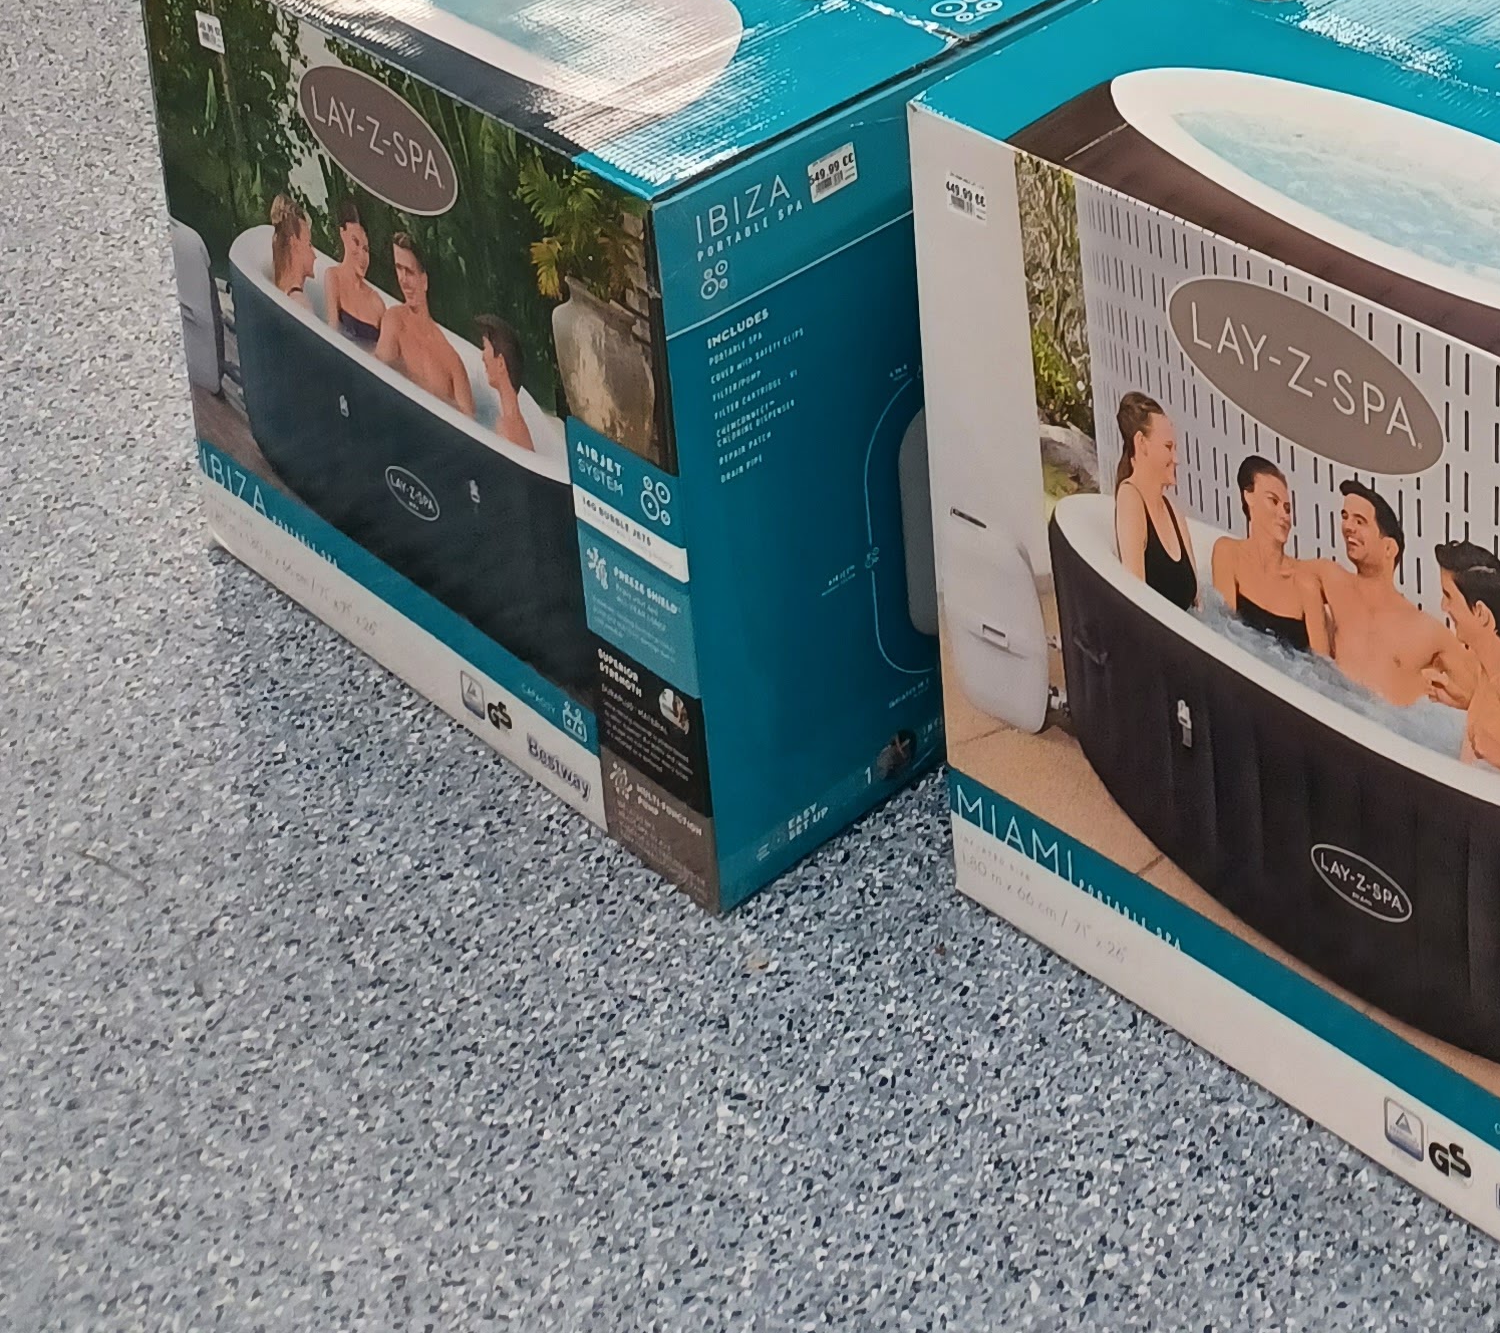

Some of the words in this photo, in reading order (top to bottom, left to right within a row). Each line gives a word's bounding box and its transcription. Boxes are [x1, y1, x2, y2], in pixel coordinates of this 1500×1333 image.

[311, 85, 445, 190] LAY-Z-SPA
[696, 174, 790, 244] IBIZA
[697, 217, 768, 262] PORTABLE
[777, 200, 803, 221] SPA
[706, 308, 769, 349] INCLUDES
[1191, 301, 1423, 449] LAY-Z-SPA
[576, 441, 622, 477] AIRJET
[578, 458, 624, 497] SYSTEM
[202, 448, 267, 518] IBIZA
[598, 507, 630, 533] BUBBLE
[632, 527, 652, 546] JETS
[613, 566, 645, 596] FREEZE
[598, 648, 639, 683] SUPERIOR
[599, 662, 642, 698] STRENGTH
[487, 701, 513, 730] GS
[527, 733, 591, 802] Bestway
[956, 784, 1073, 884] MIAMI
[1321, 852, 1404, 913] LAY-Z-SPA
[1429, 1142, 1471, 1178] GS
